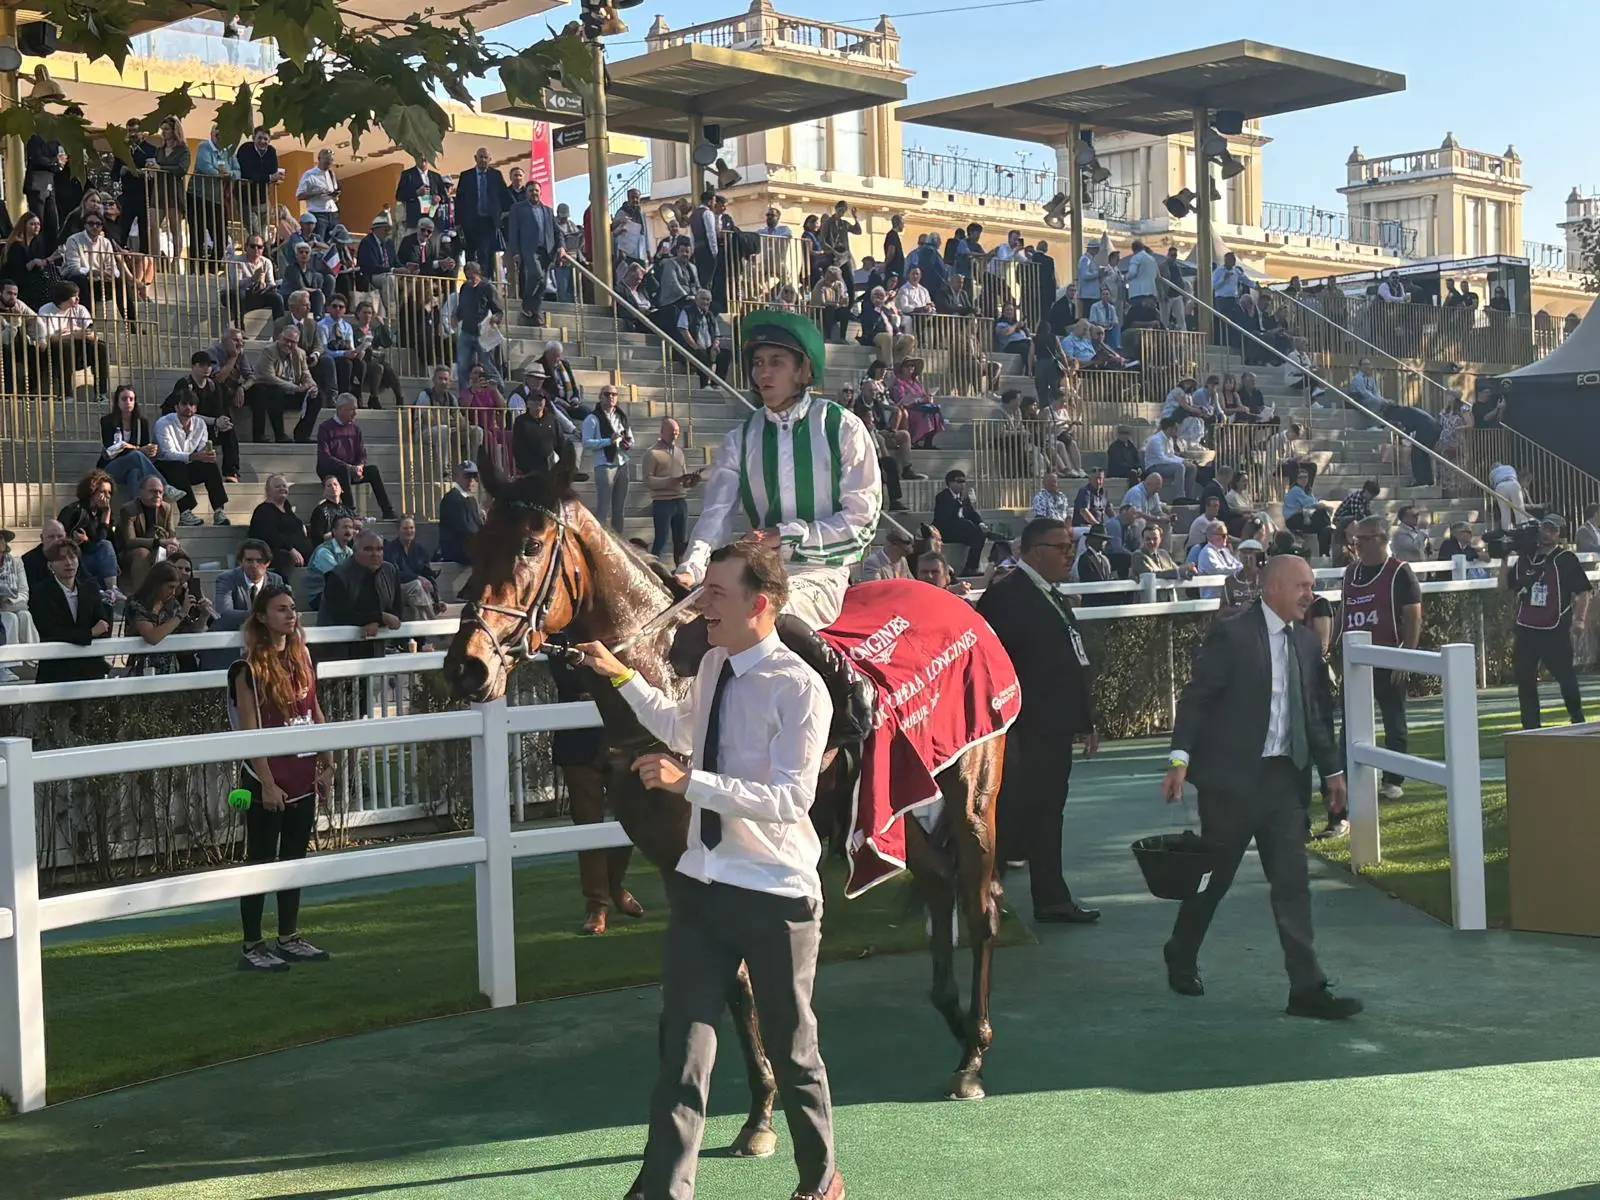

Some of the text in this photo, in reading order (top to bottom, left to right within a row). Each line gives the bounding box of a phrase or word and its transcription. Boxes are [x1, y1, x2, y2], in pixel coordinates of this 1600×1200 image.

[850, 615, 910, 661] ONGINES
[1347, 610, 1379, 628] 104
[925, 628, 977, 681] LONGINES
